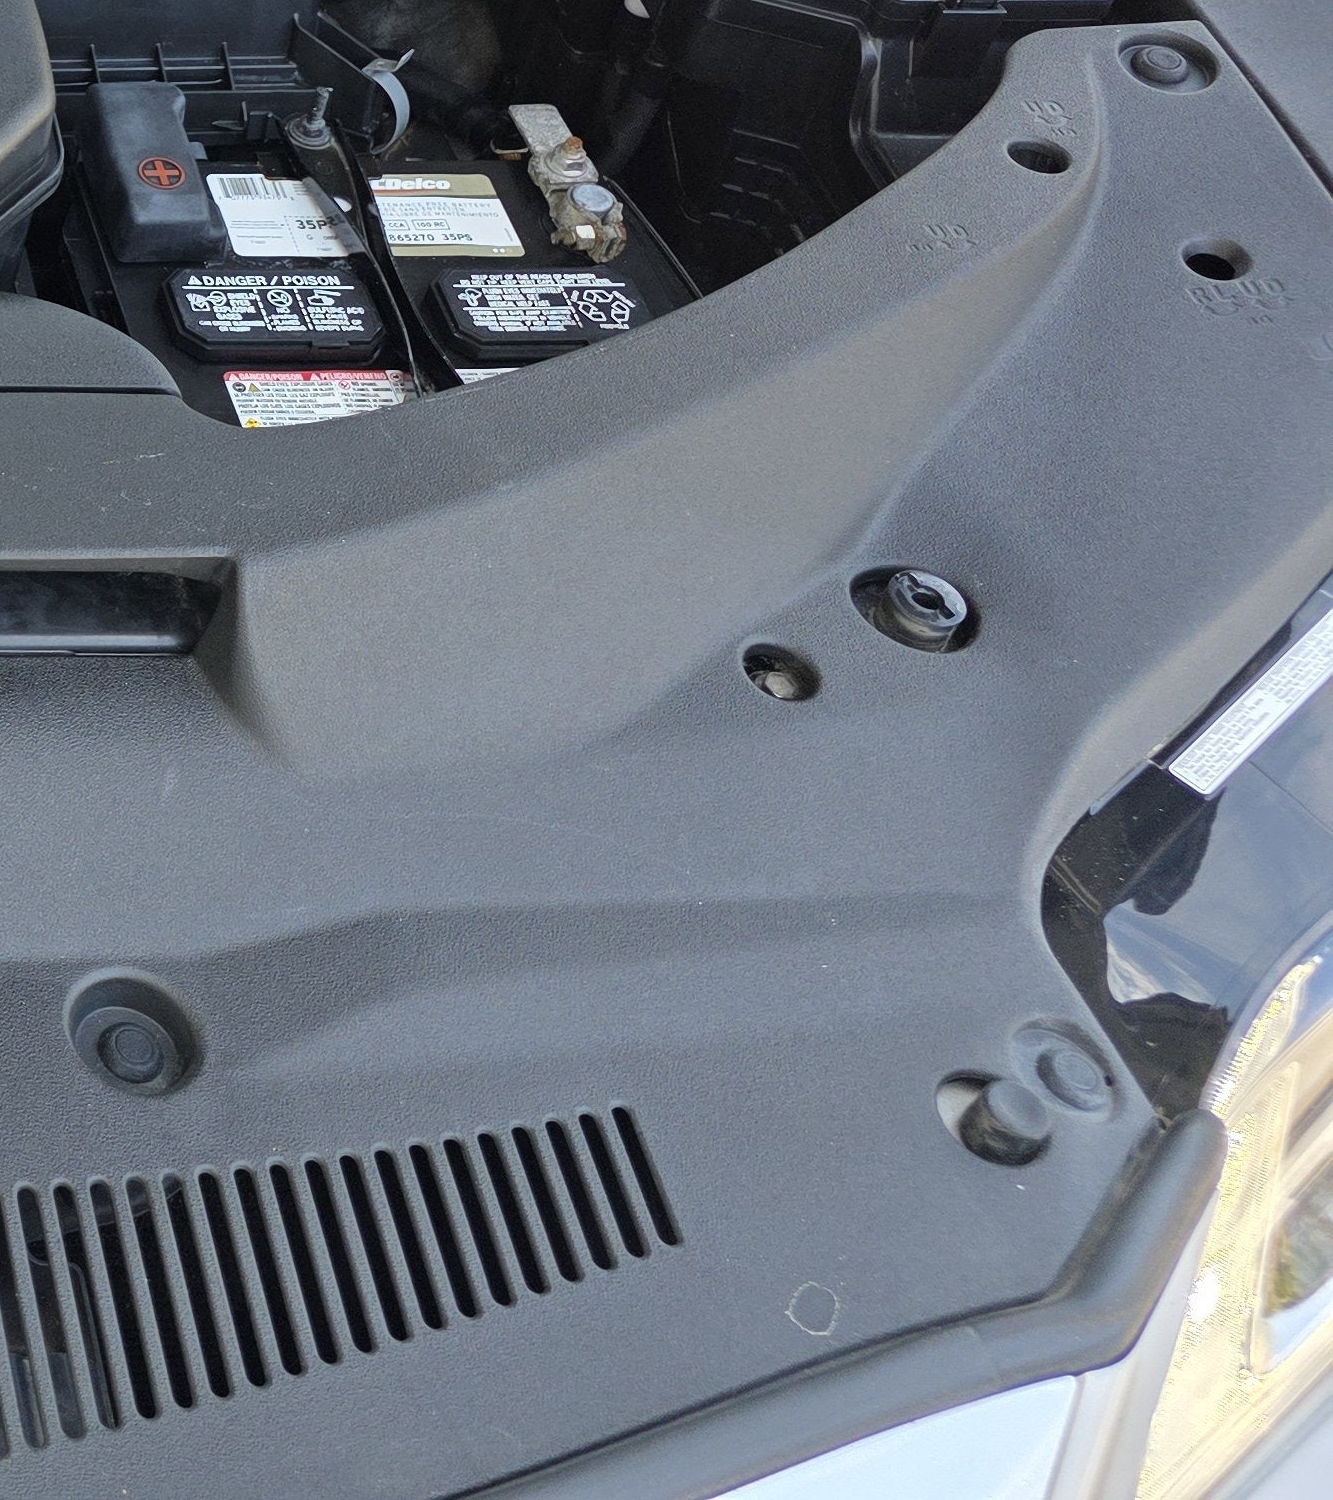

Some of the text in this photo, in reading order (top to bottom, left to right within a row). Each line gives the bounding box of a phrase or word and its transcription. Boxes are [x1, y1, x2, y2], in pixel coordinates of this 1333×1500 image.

[441, 233, 473, 241] 35PS
[202, 275, 268, 286] DANGER
[281, 275, 341, 286] POISON
